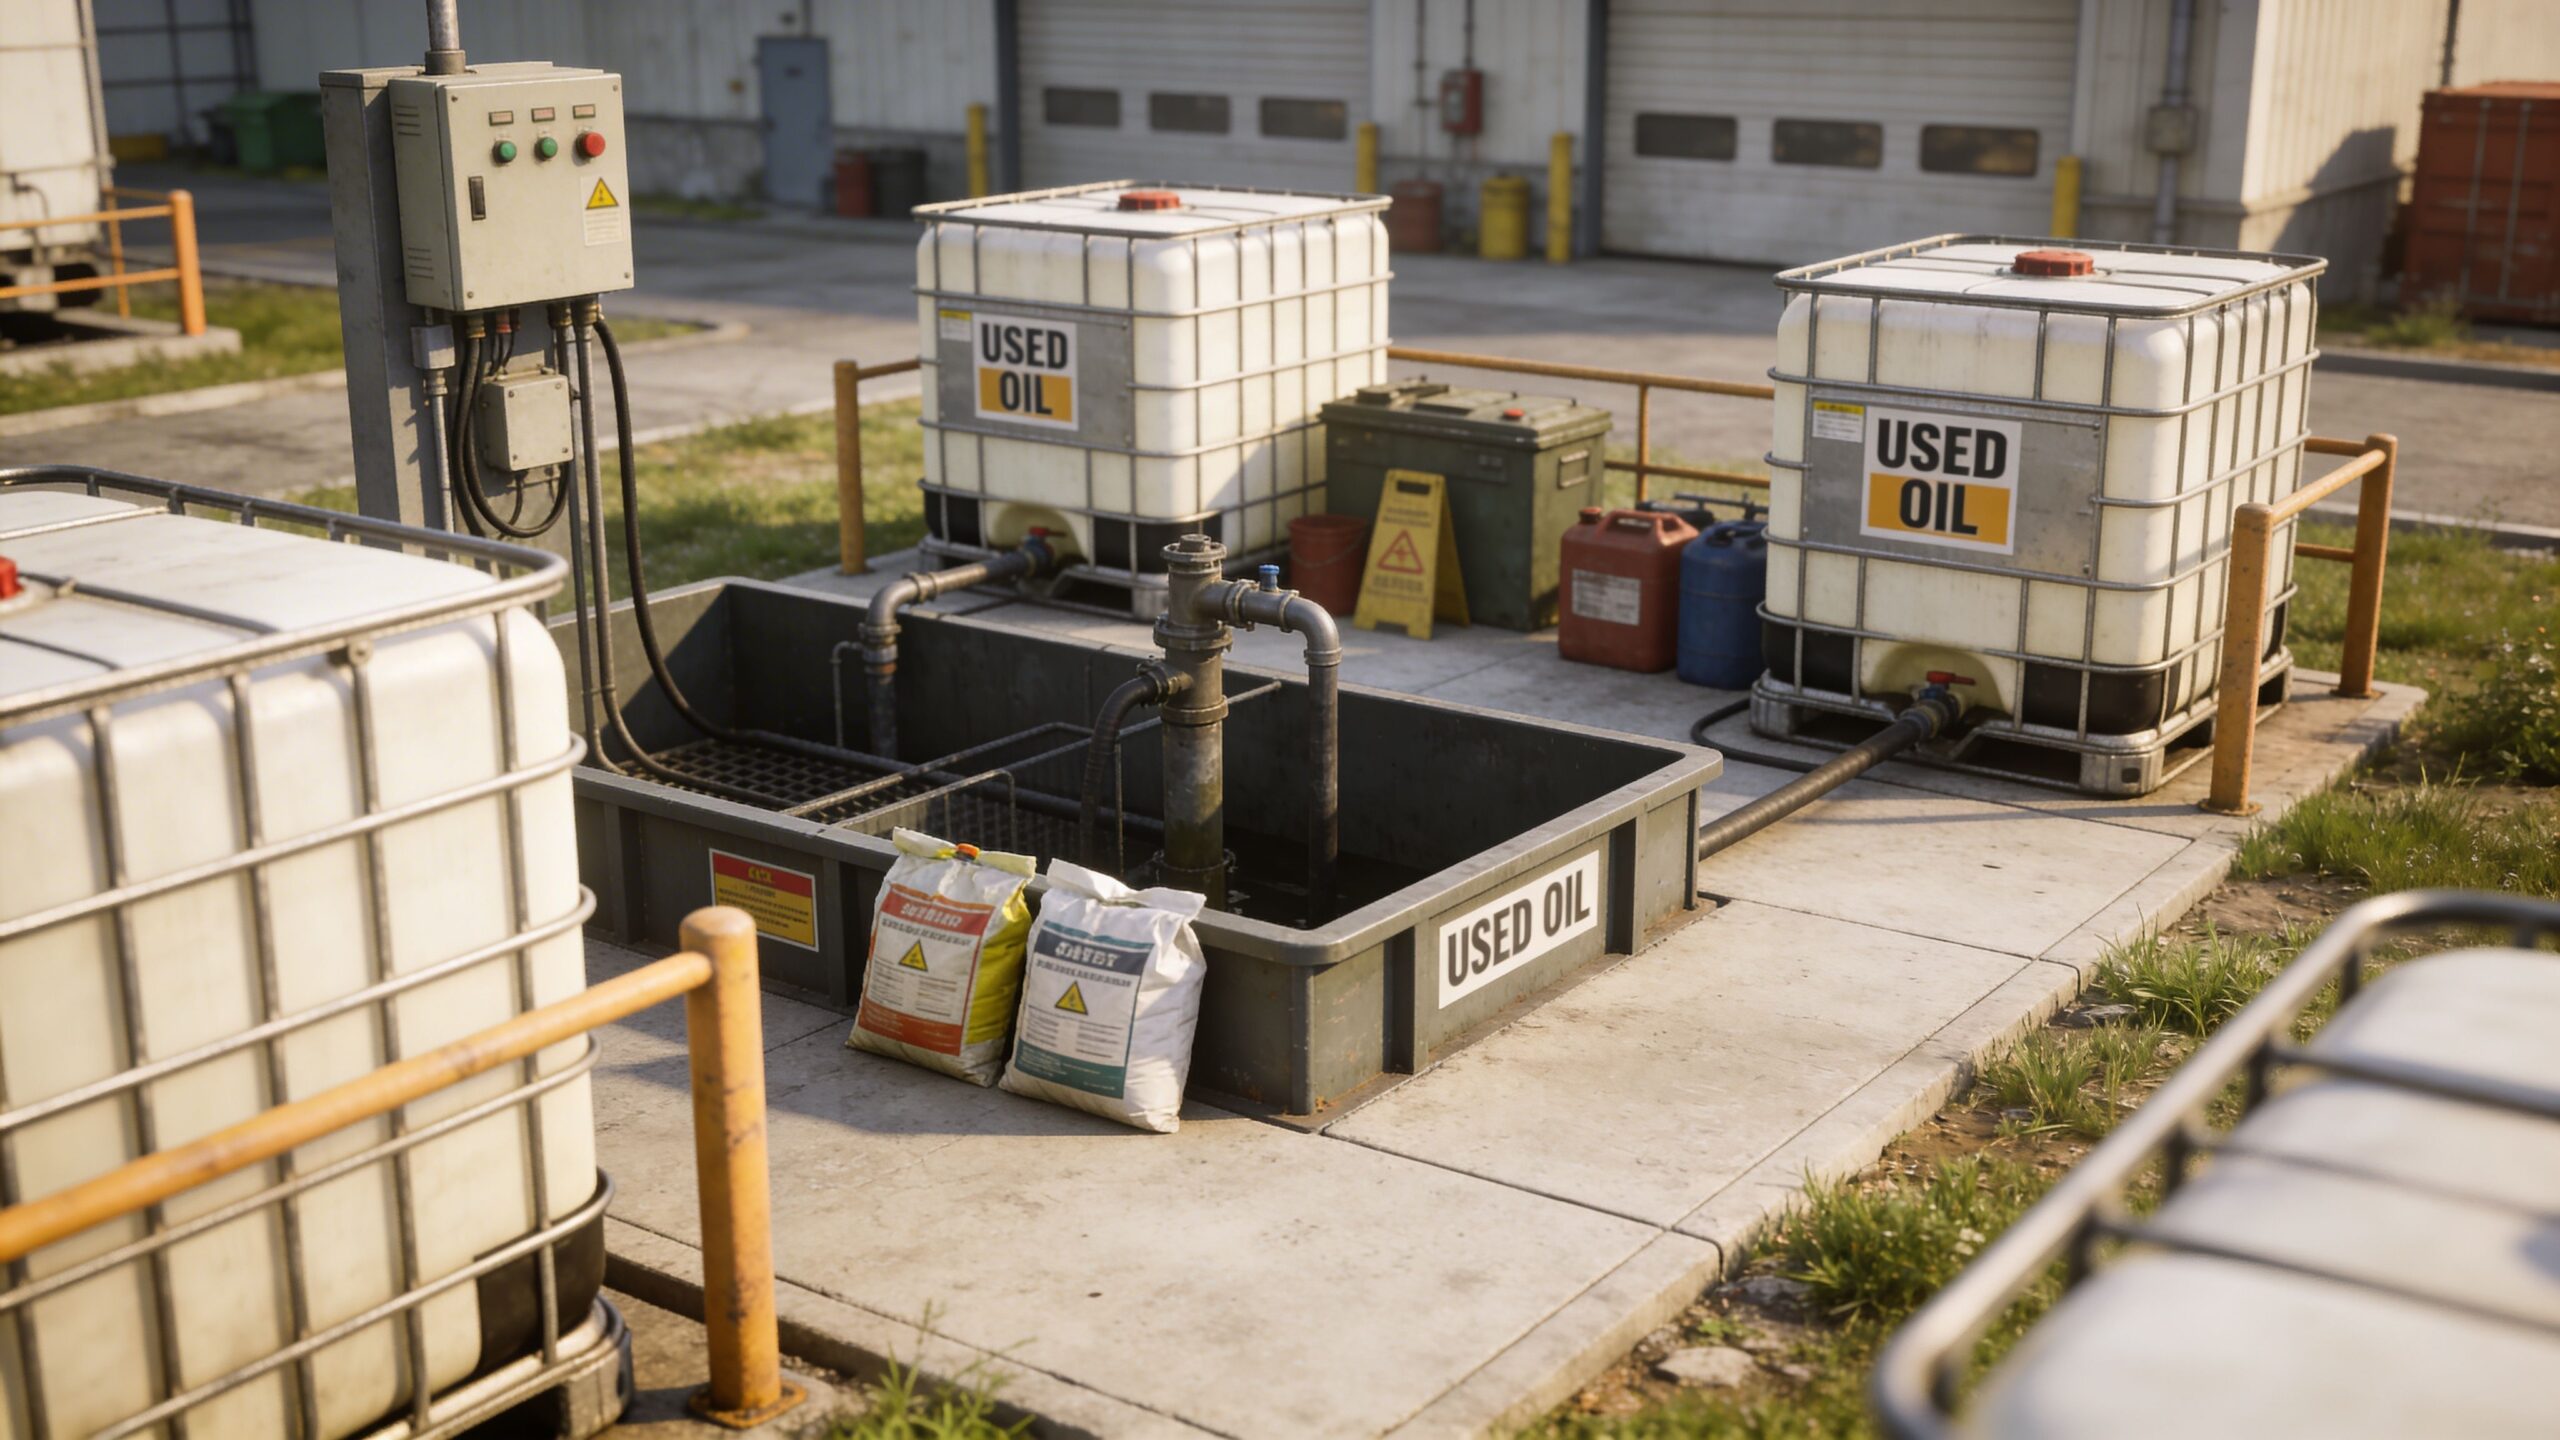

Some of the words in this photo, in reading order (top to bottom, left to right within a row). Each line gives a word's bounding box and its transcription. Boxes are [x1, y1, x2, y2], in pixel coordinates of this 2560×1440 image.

[981, 322, 1068, 369] USED
[999, 371, 1053, 415] OIL
[1877, 418, 2008, 479] USED
[1899, 479, 1978, 535] OIL
[1447, 898, 1532, 987] USED
[1543, 869, 1590, 937] OIL
